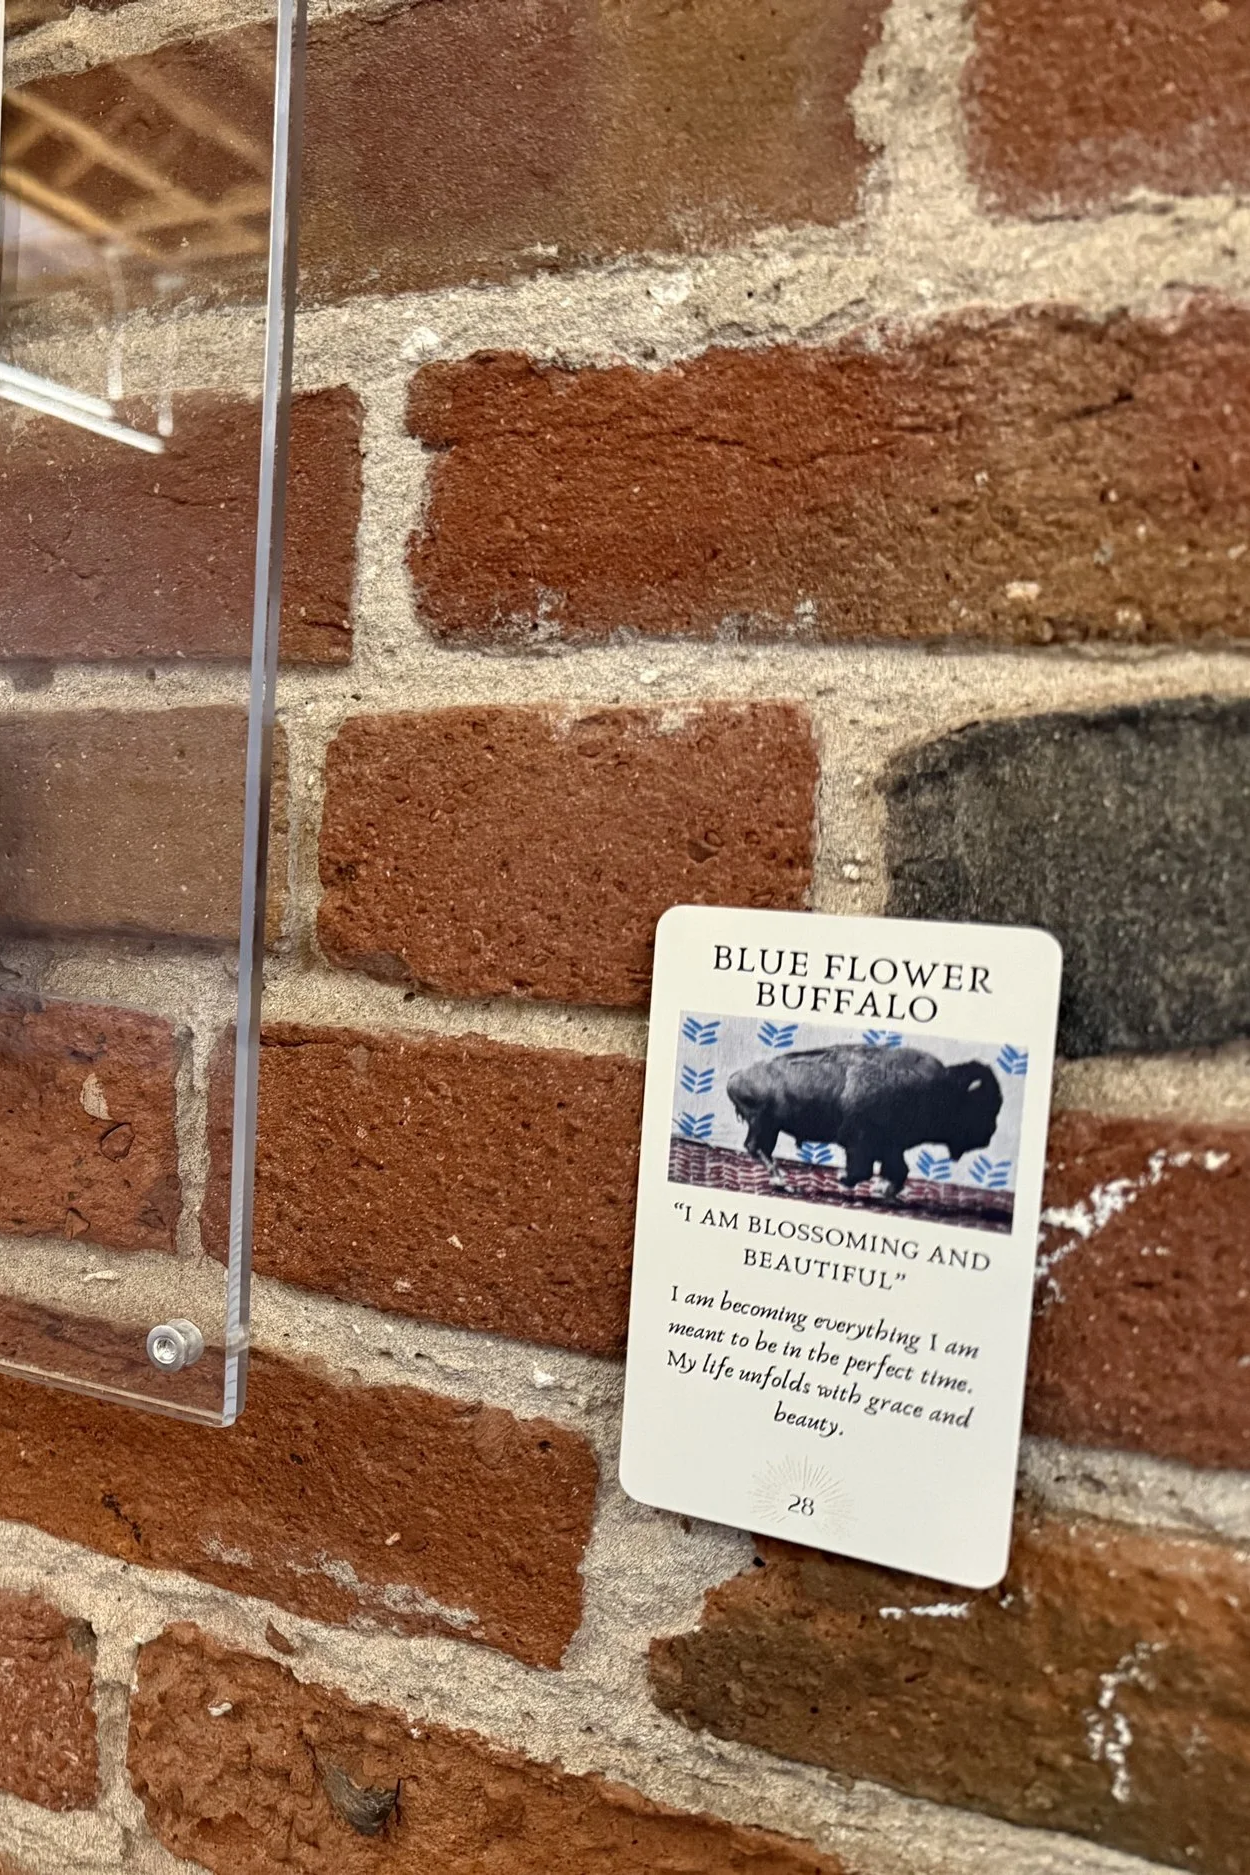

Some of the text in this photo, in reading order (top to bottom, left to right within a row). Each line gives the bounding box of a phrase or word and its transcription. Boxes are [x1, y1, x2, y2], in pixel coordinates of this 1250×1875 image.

[713, 945, 993, 994] BLUE FLOWER
[755, 982, 938, 1023] BUFFALO
[673, 1202, 991, 1272] “I AM BLOSSOMING AND
[743, 1249, 907, 1291] BEAUTIFUL”
[670, 1285, 979, 1359] I am becoming everything I am
[667, 1319, 973, 1394] meant to be in the perfect time.
[666, 1350, 973, 1429] My life unfolds with grace and
[773, 1401, 844, 1439] beauty.
[787, 1494, 815, 1516] 28
